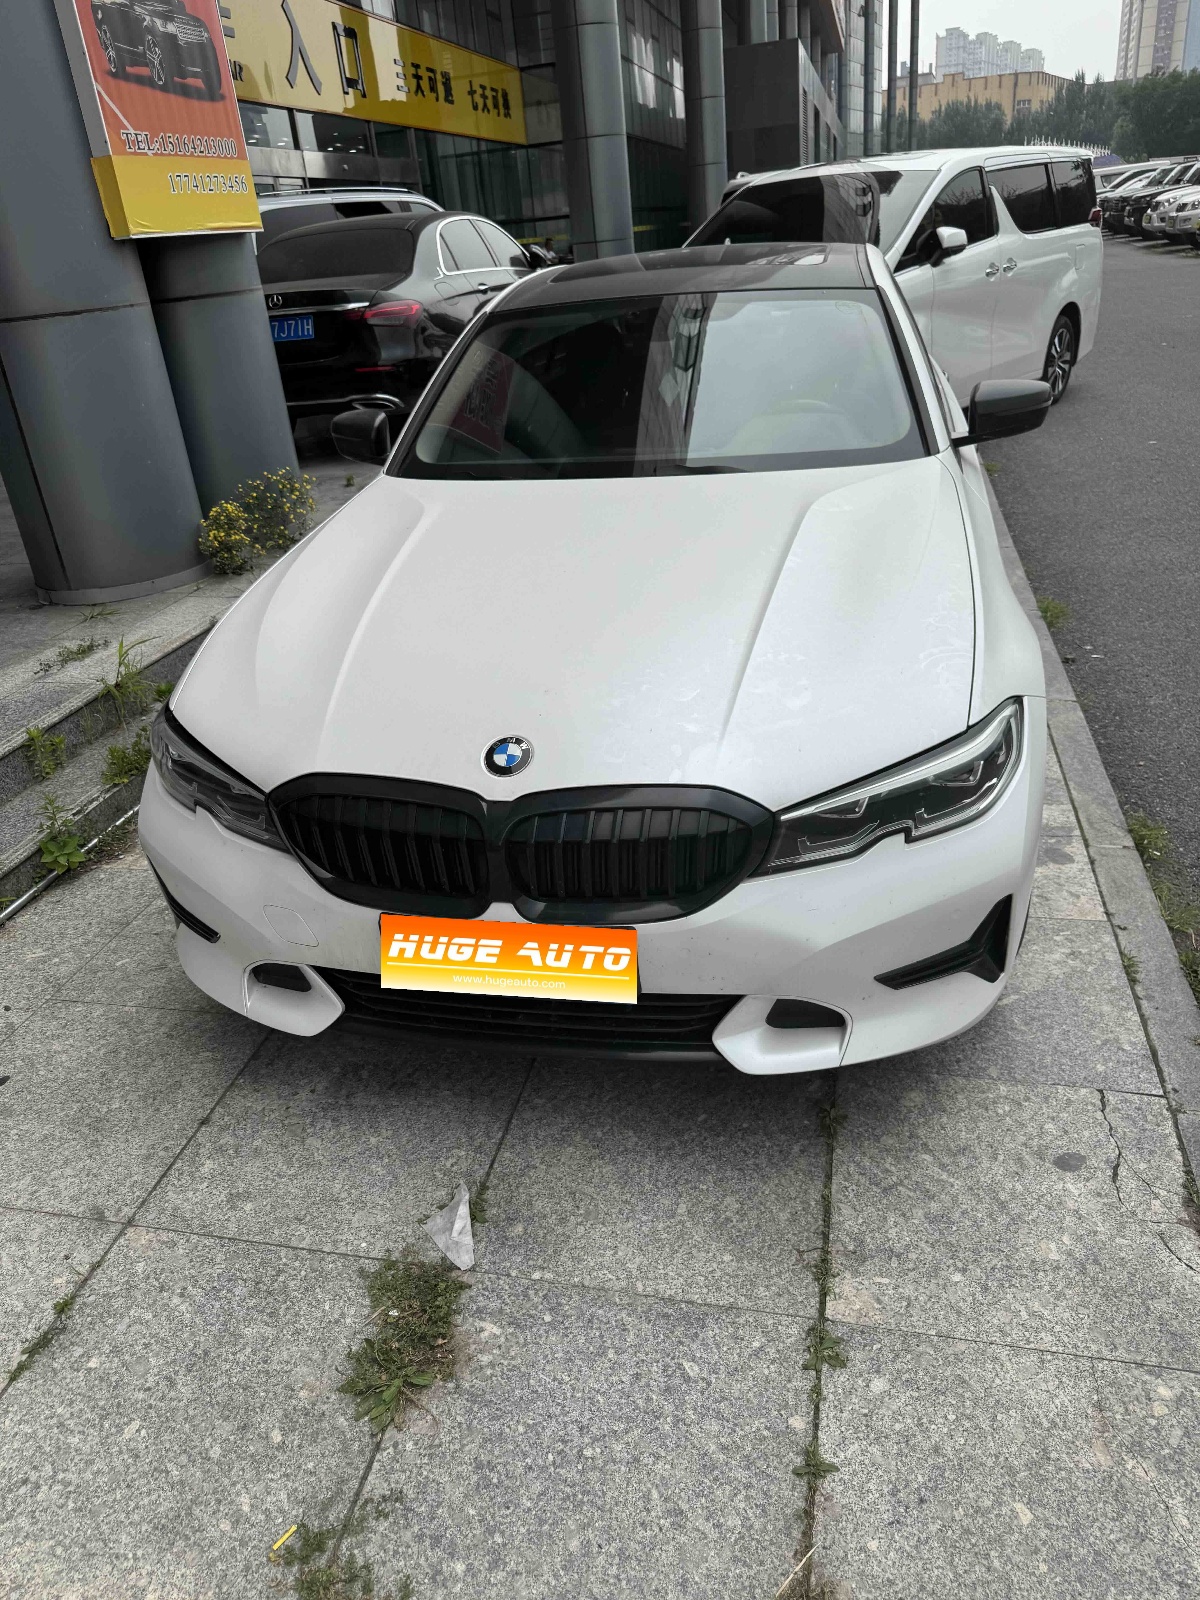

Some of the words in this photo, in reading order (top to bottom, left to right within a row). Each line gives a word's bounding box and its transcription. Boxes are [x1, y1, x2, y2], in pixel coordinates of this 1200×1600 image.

[281, 0, 367, 98] 入口
[394, 58, 455, 105] 三天可退
[120, 130, 238, 157] TEL:15164213000
[168, 172, 249, 194] 17741273456
[271, 318, 313, 338] 7J71H
